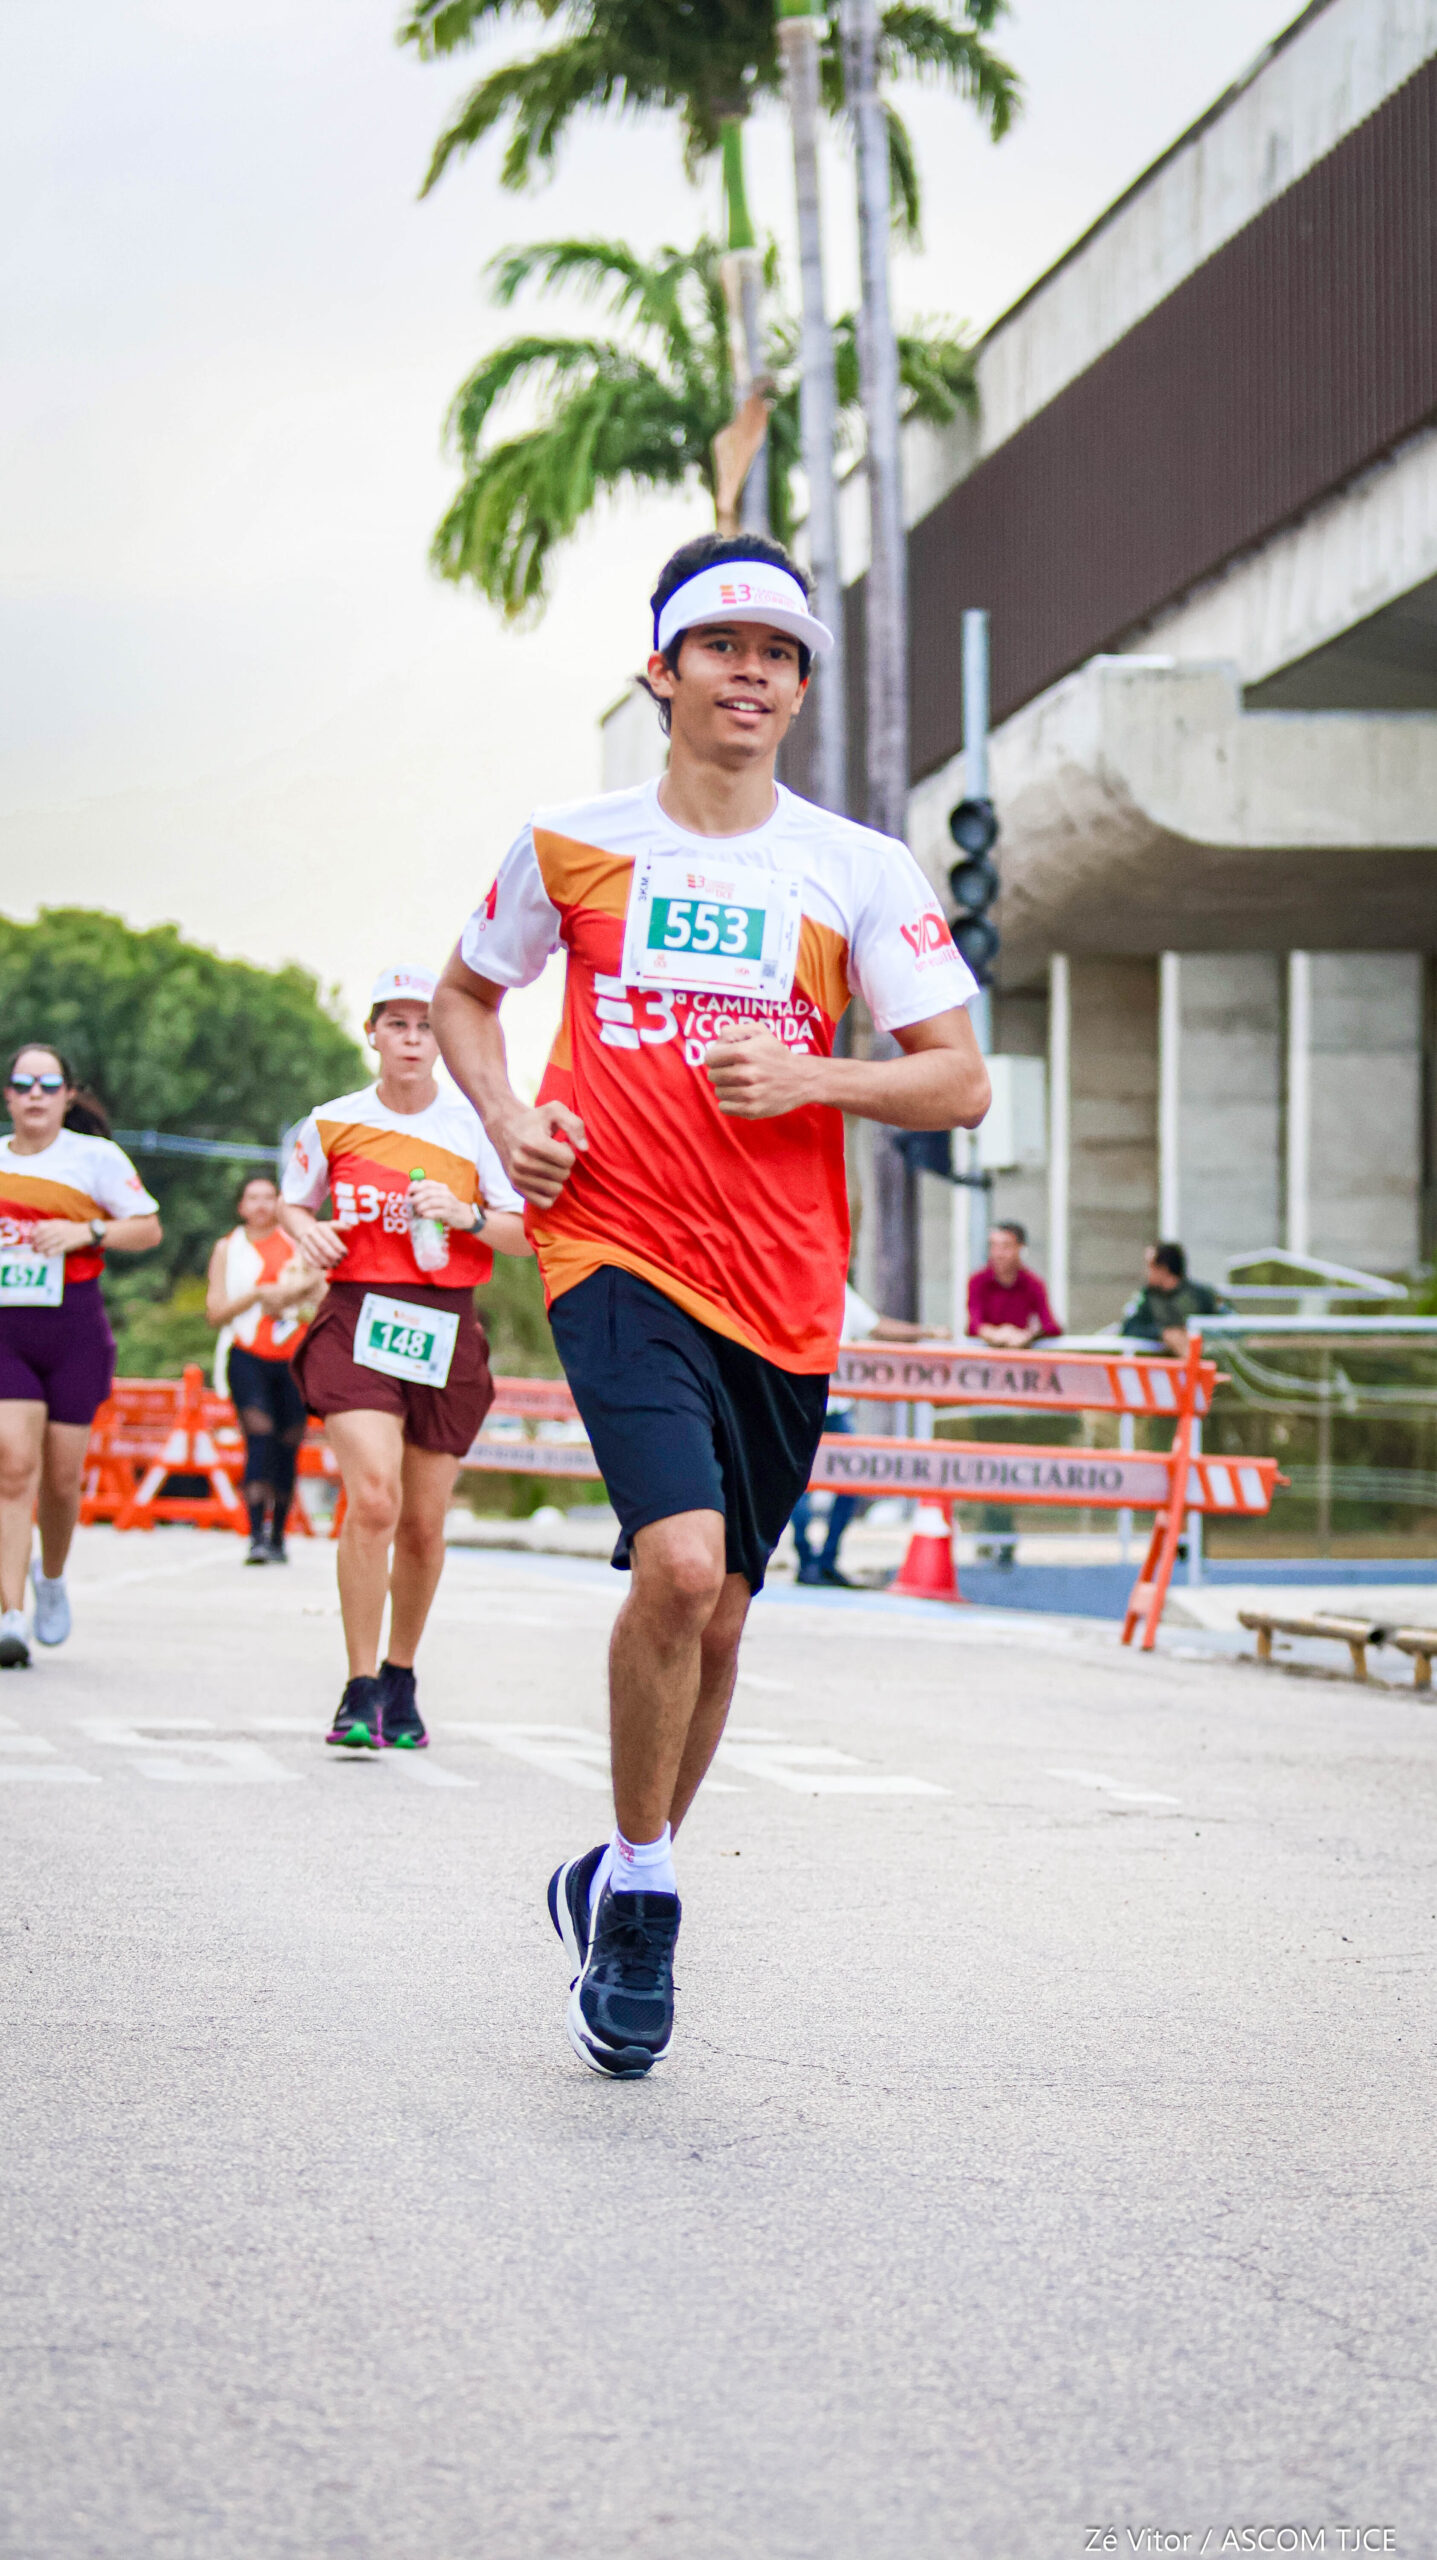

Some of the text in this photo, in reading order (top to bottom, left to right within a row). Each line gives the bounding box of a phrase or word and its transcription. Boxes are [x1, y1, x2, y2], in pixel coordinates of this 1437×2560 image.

[663, 900, 749, 954] 553
[693, 994, 822, 1022] CAMINHADA
[379, 1323, 427, 1358] 148
[902, 1363, 951, 1389] DO
[825, 1450, 932, 1482] PODER
